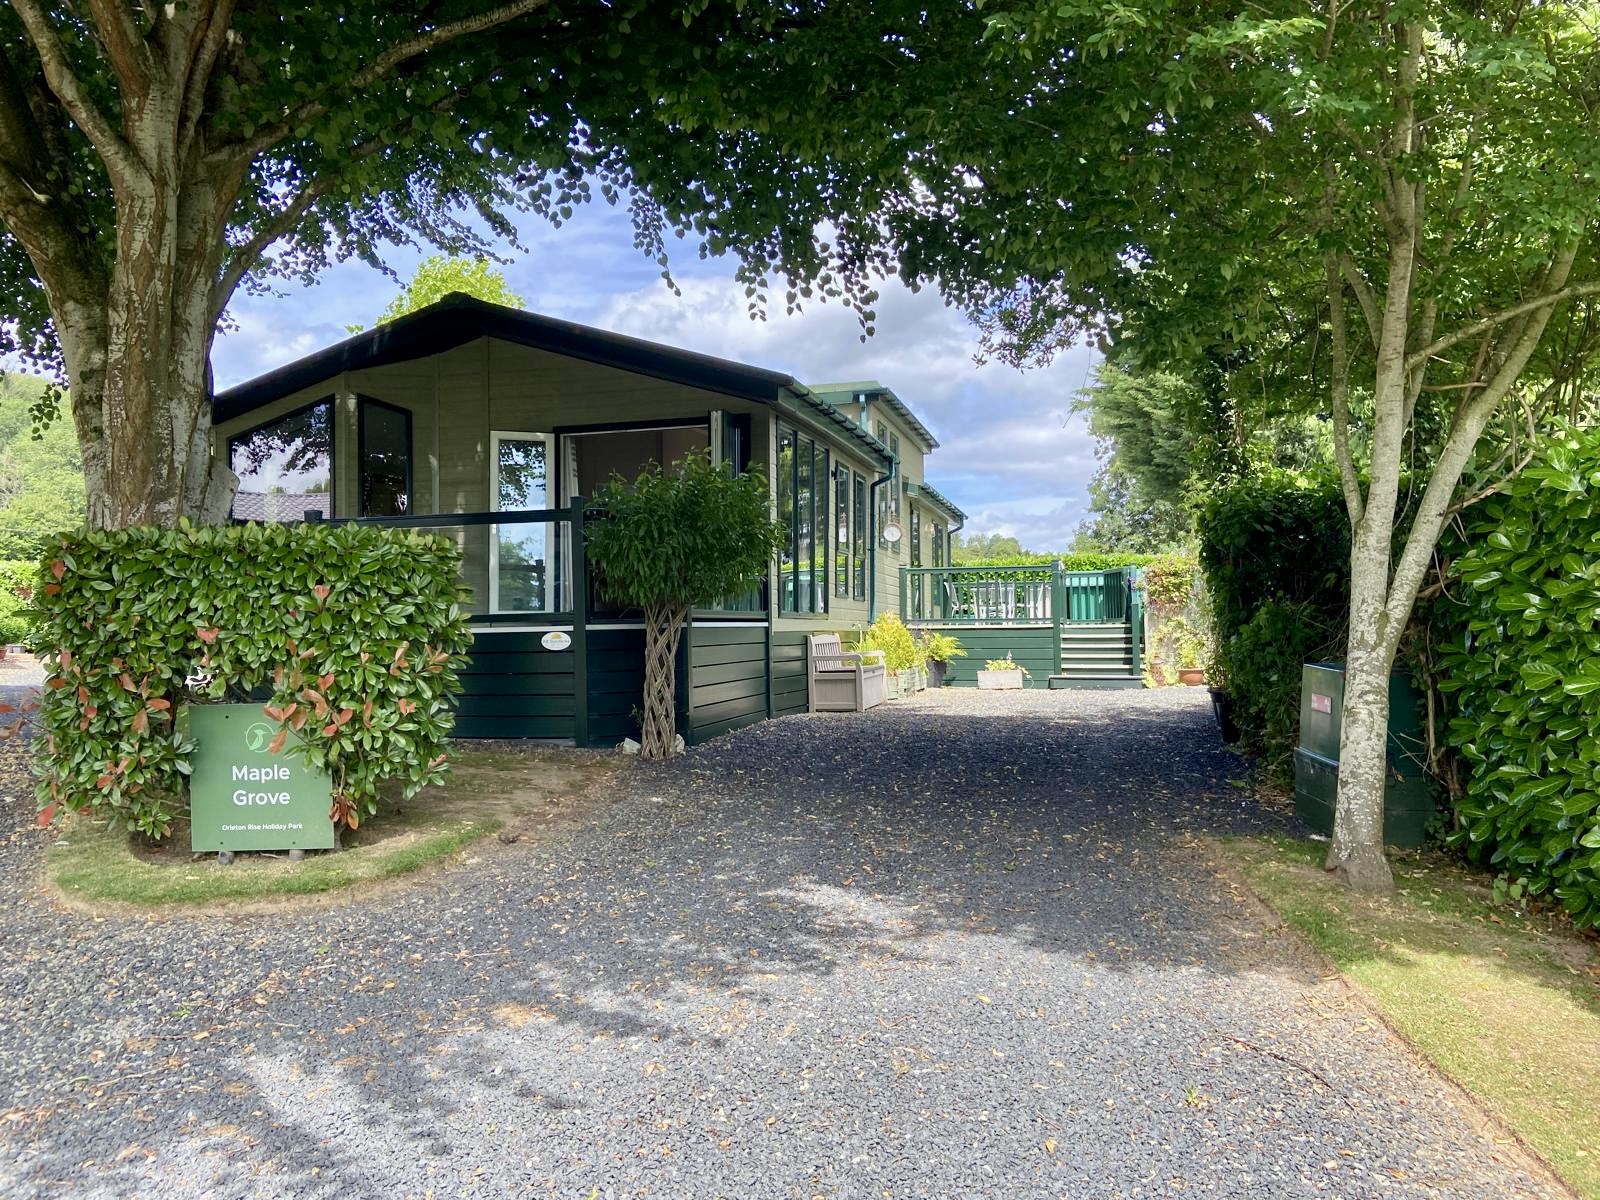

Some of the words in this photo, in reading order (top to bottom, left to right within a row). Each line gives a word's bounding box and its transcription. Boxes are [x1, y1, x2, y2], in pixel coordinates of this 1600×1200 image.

[232, 764, 290, 783] Maple
[232, 790, 290, 806] Grove
[247, 823, 261, 831] Rise
[262, 822, 287, 831] Holiday
[288, 822, 303, 830] Park
